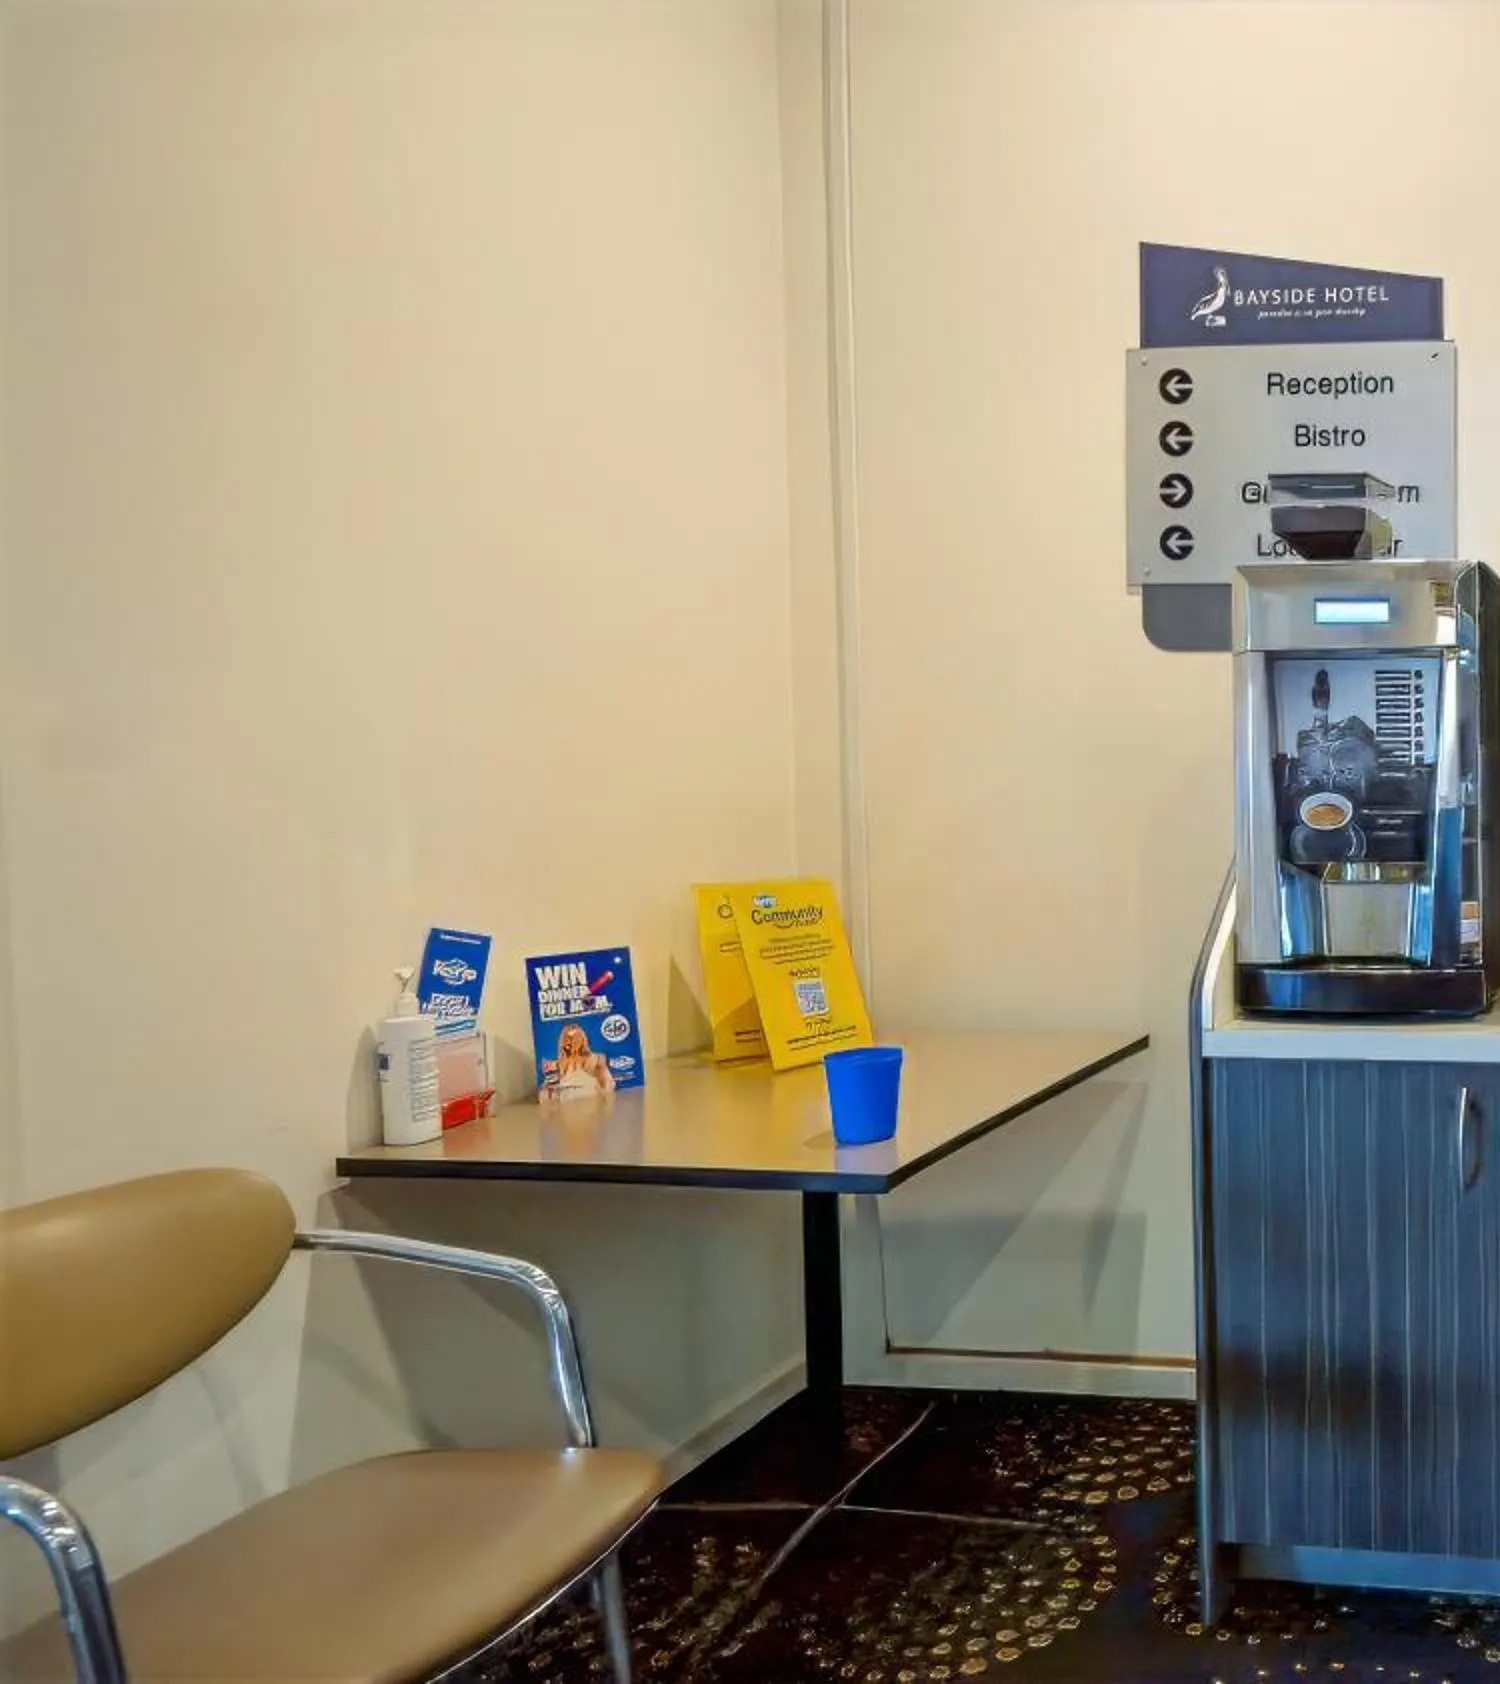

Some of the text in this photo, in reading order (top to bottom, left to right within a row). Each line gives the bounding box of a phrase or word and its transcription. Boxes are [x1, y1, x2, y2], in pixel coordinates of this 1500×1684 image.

[1233, 285, 1389, 306] BAYSIDE HOTEL
[1266, 371, 1395, 400] Reception
[1294, 423, 1367, 448] Bistro
[534, 961, 588, 990] WIN
